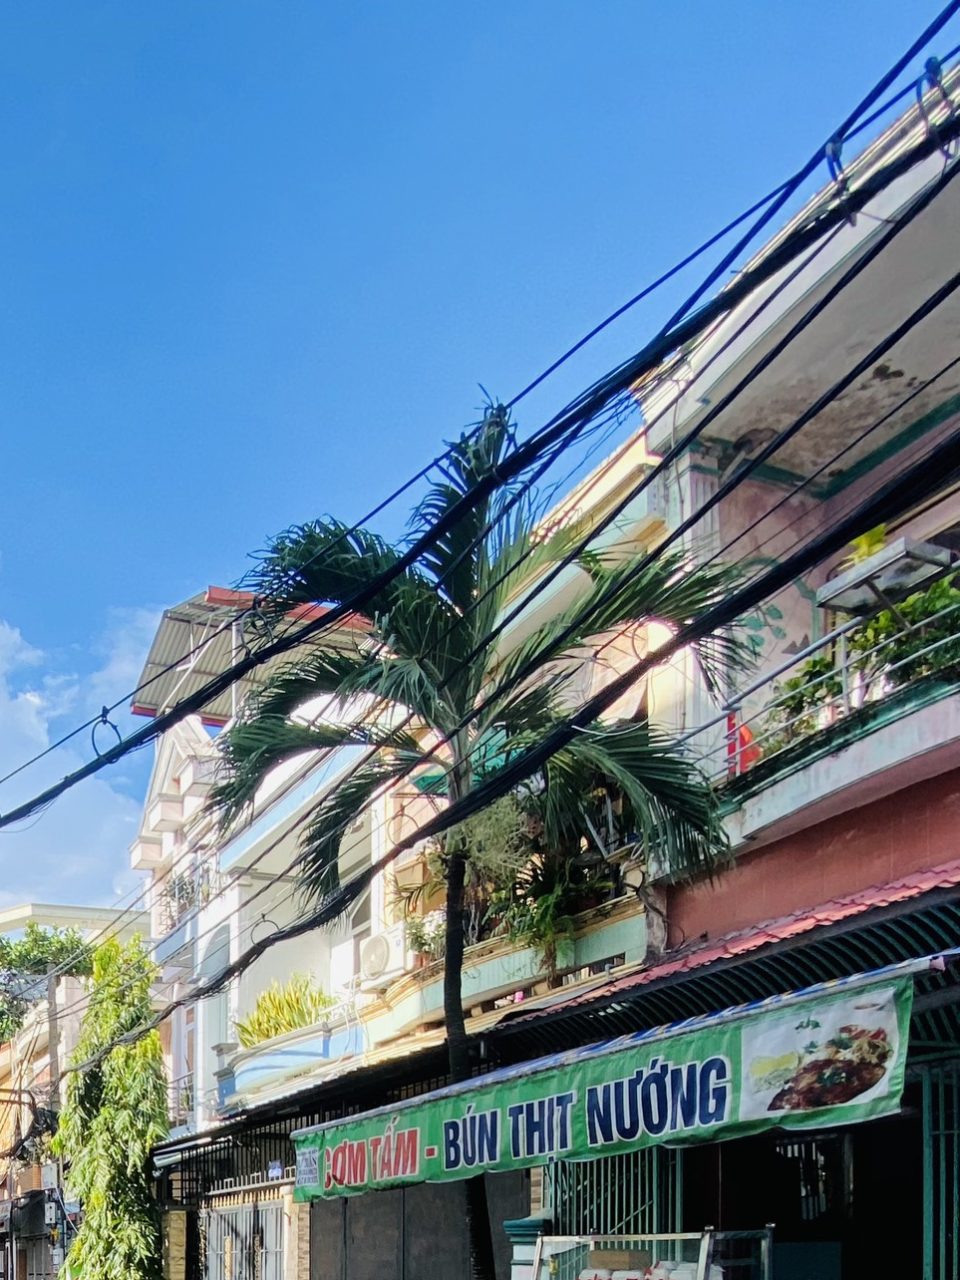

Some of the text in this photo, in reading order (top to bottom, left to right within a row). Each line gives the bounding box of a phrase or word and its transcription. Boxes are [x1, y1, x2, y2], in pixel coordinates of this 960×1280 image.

[324, 1139, 366, 1189] CƠM
[369, 1115, 419, 1181] TẤM
[444, 1105, 499, 1171] BÚN
[508, 1092, 574, 1162] THỊT
[587, 1056, 727, 1146] NƯỚNG
